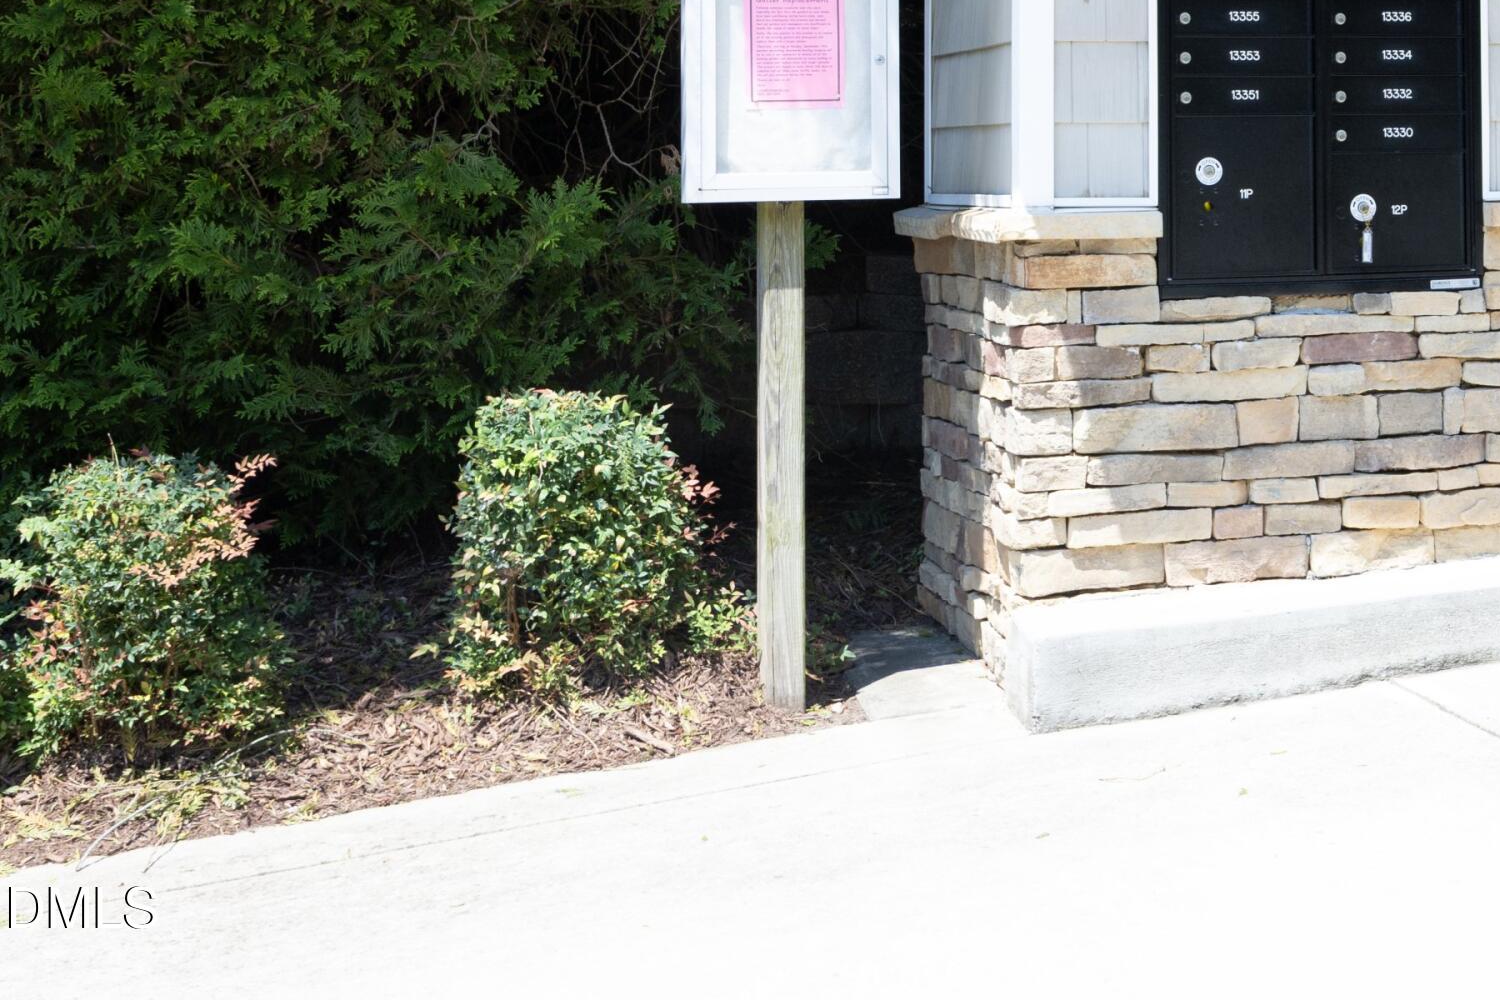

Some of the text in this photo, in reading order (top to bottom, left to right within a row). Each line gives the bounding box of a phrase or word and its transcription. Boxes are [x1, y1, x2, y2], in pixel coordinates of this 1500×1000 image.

[1228, 10, 1261, 22] 13355
[1381, 11, 1413, 23] 13336
[1228, 49, 1261, 62] 13353
[1381, 49, 1413, 61] 13334
[1230, 89, 1260, 101] 13351
[1382, 88, 1413, 100] 13332
[1382, 126, 1414, 138] 13330
[1239, 187, 1254, 200] 11P
[1390, 204, 1409, 216] 12P
